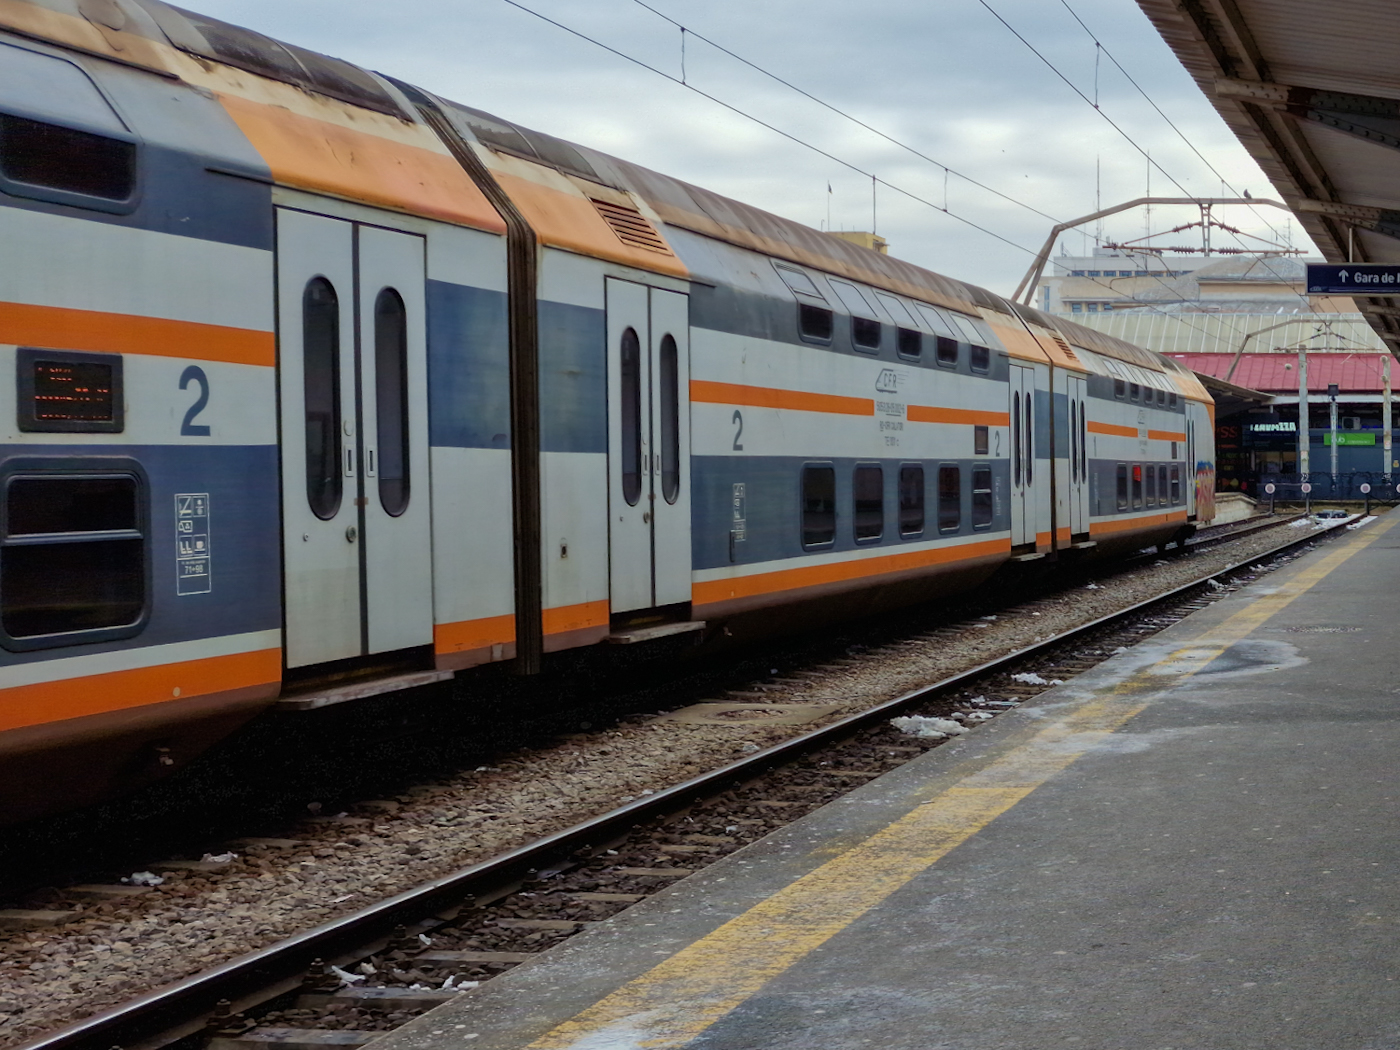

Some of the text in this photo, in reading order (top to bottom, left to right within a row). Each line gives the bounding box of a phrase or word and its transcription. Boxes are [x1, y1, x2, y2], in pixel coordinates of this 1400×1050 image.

[1354, 272, 1379, 283] Gara
[1381, 272, 1394, 283] de
[178, 365, 211, 436] 2
[732, 410, 744, 451] 2
[994, 430, 1000, 457] 2
